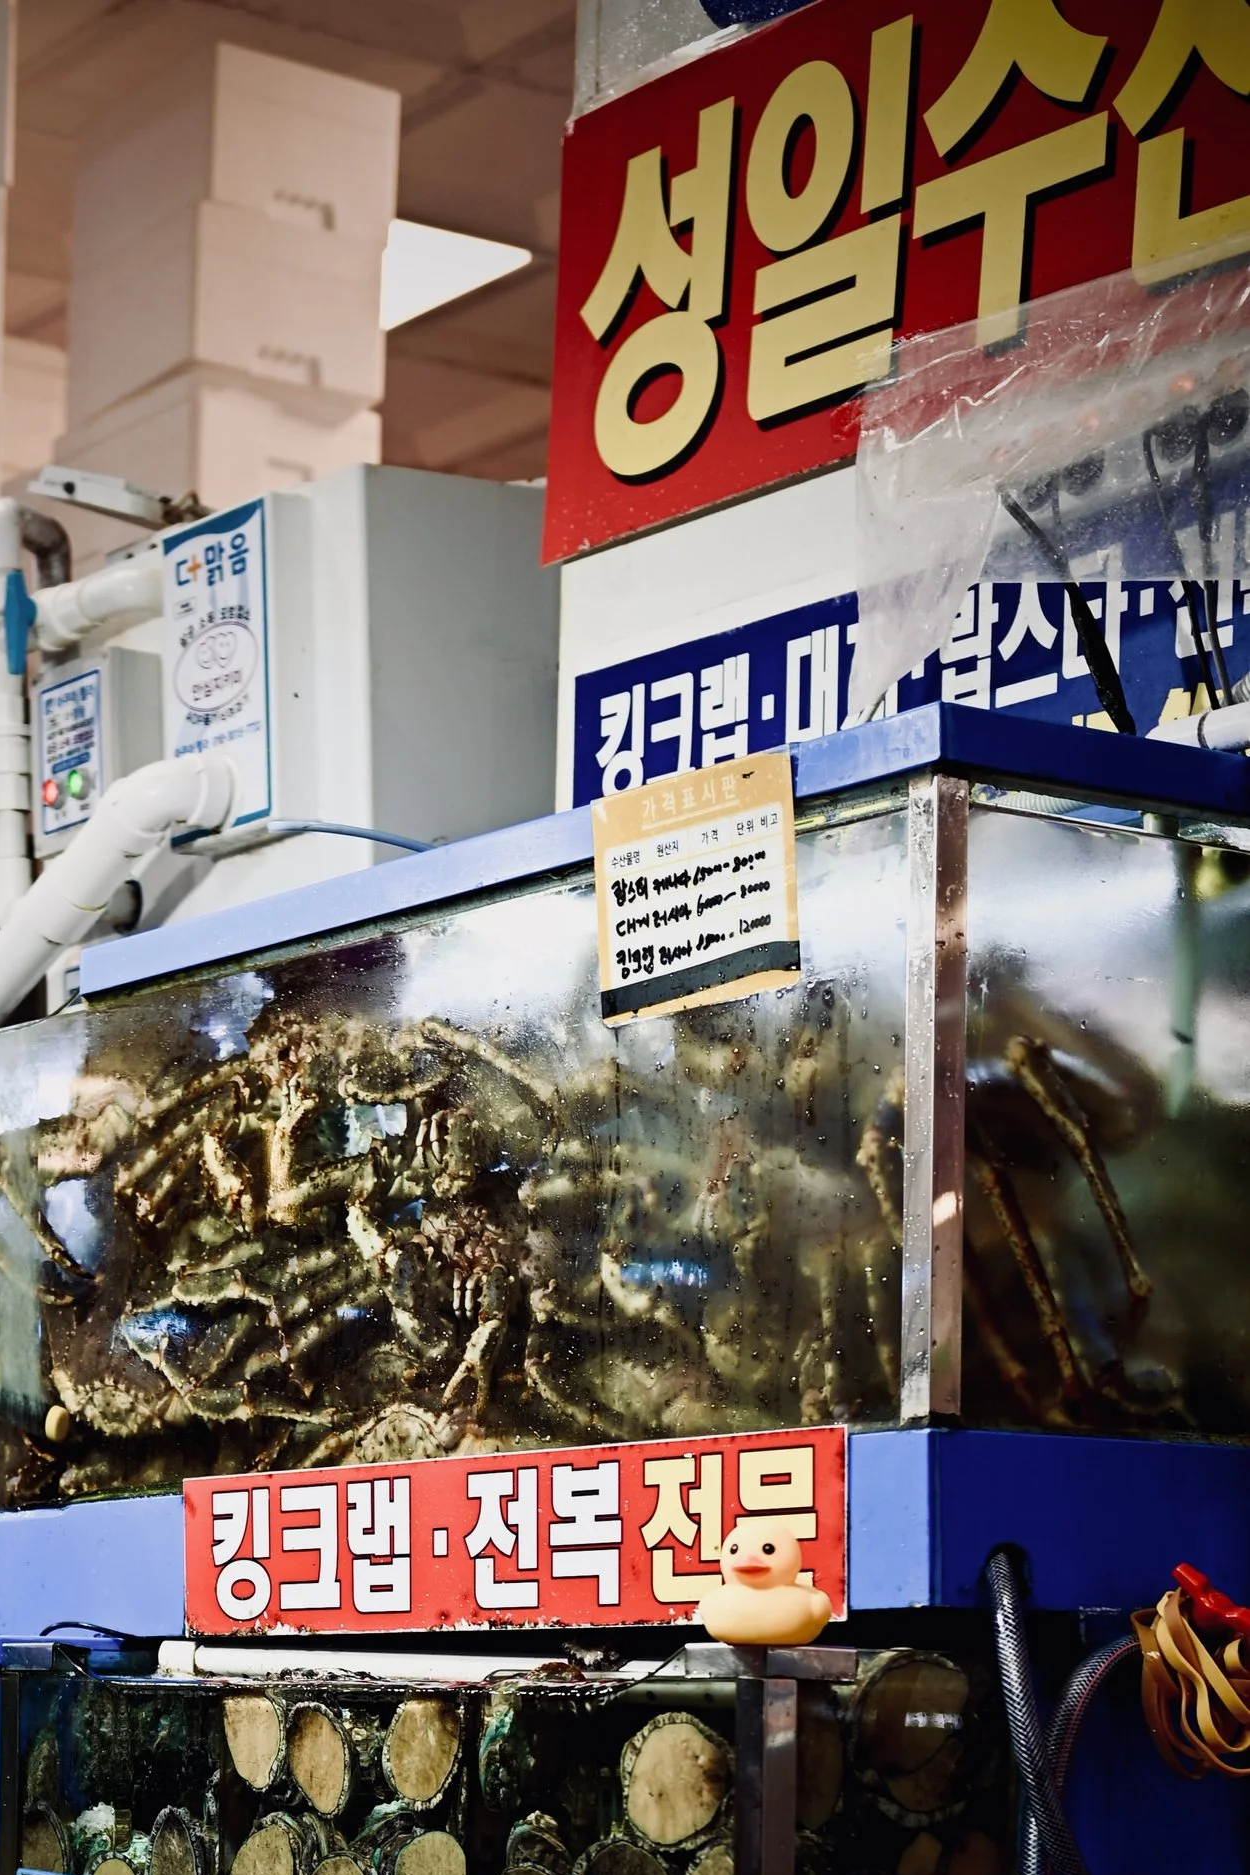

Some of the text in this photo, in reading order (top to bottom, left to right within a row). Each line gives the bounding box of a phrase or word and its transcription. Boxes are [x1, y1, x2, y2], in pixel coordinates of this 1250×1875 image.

[642, 774, 738, 821] 가격표시판
[611, 813, 778, 867] 수산물명 원산지 가격 단위 비고
